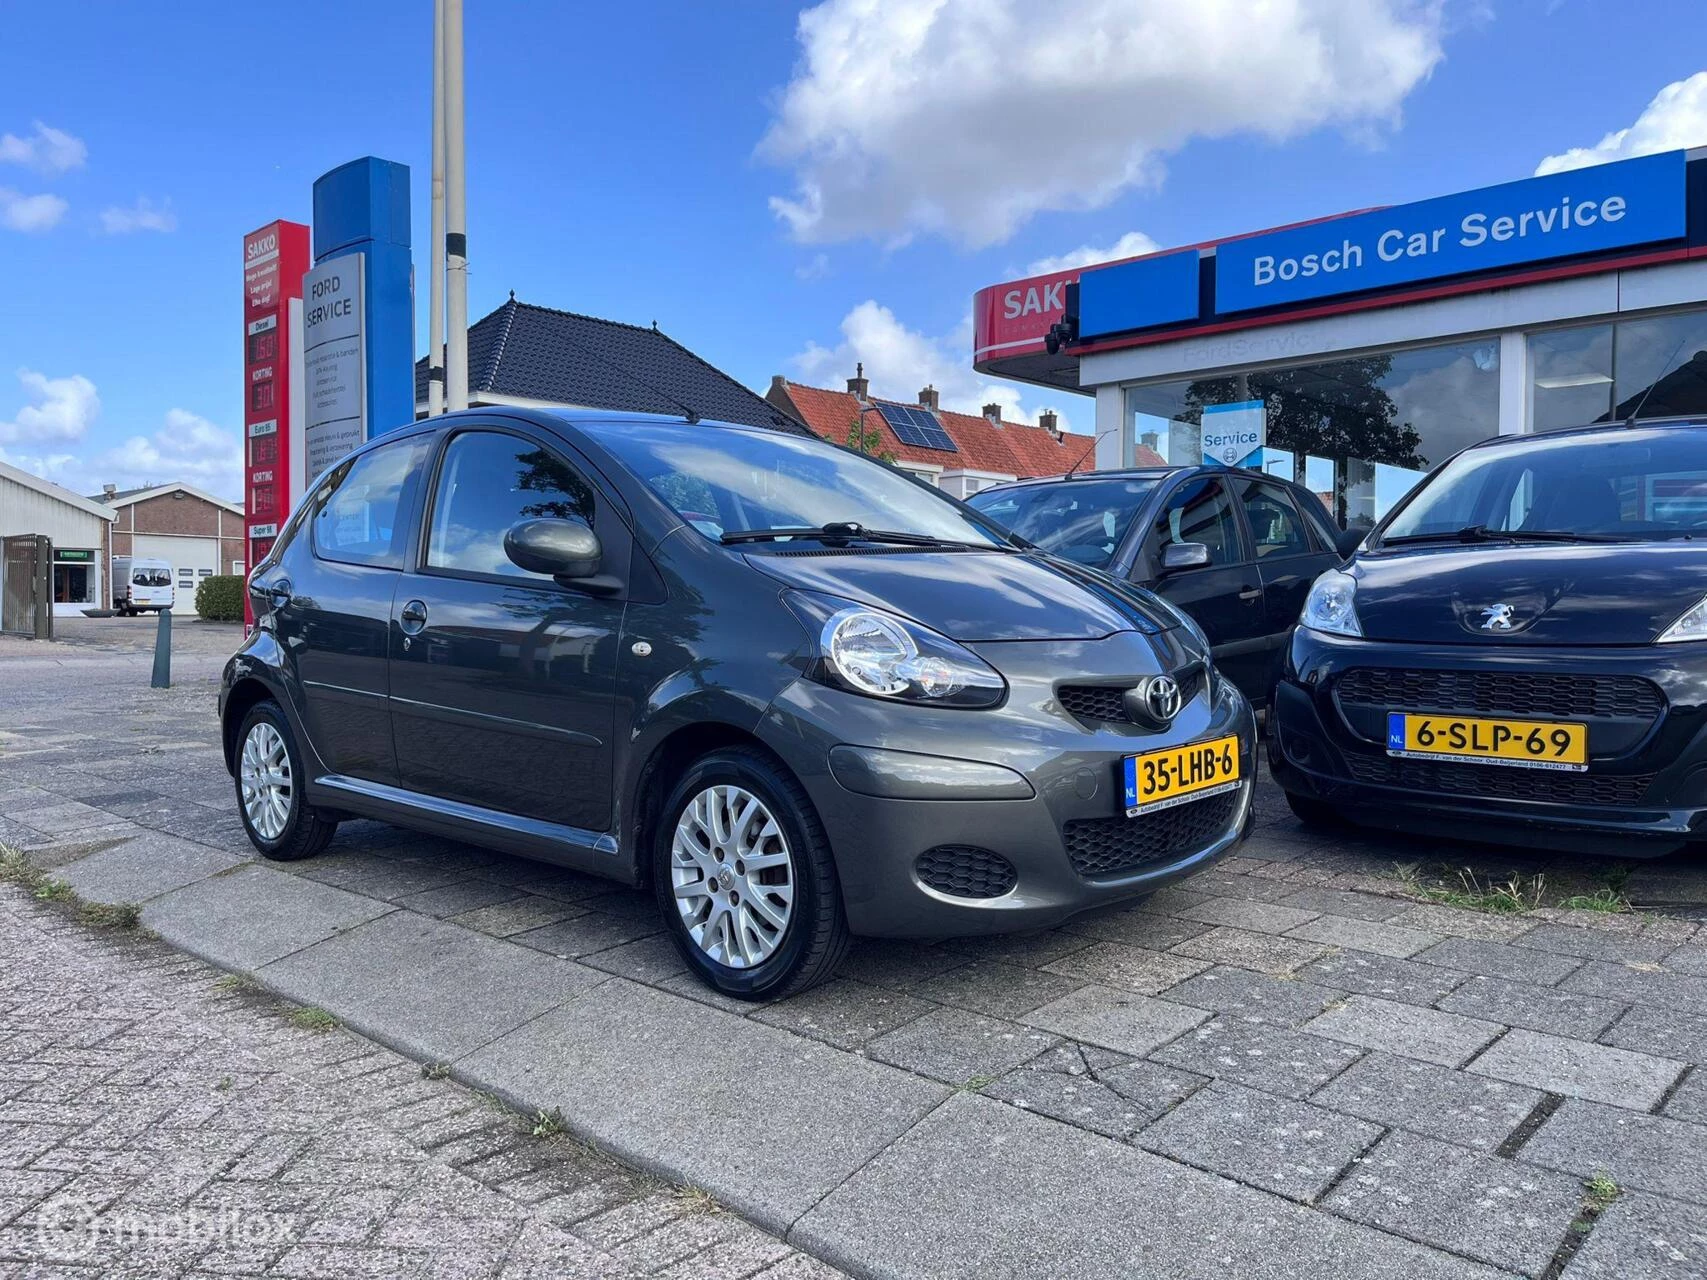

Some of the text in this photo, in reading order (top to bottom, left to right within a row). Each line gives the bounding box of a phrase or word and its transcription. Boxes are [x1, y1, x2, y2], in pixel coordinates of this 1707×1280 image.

[248, 234, 276, 260] SAKKO
[1254, 196, 1627, 286] Bosch Car Service
[312, 276, 340, 301] FORD
[1004, 280, 1079, 319] SAK
[307, 298, 352, 328] SERVICE
[255, 320, 270, 331] Diesel
[252, 366, 273, 382] KORTING
[254, 424, 265, 434] Euro
[1204, 431, 1258, 447] Service
[252, 470, 273, 483] KORTING
[253, 525, 266, 536] Super
[1391, 734, 1403, 744] NL
[1417, 720, 1571, 756] 6-SLP-69
[1407, 752, 1436, 760] Autobedrijf
[1143, 743, 1233, 795] 35-LHB-6
[1125, 787, 1136, 799] NL
